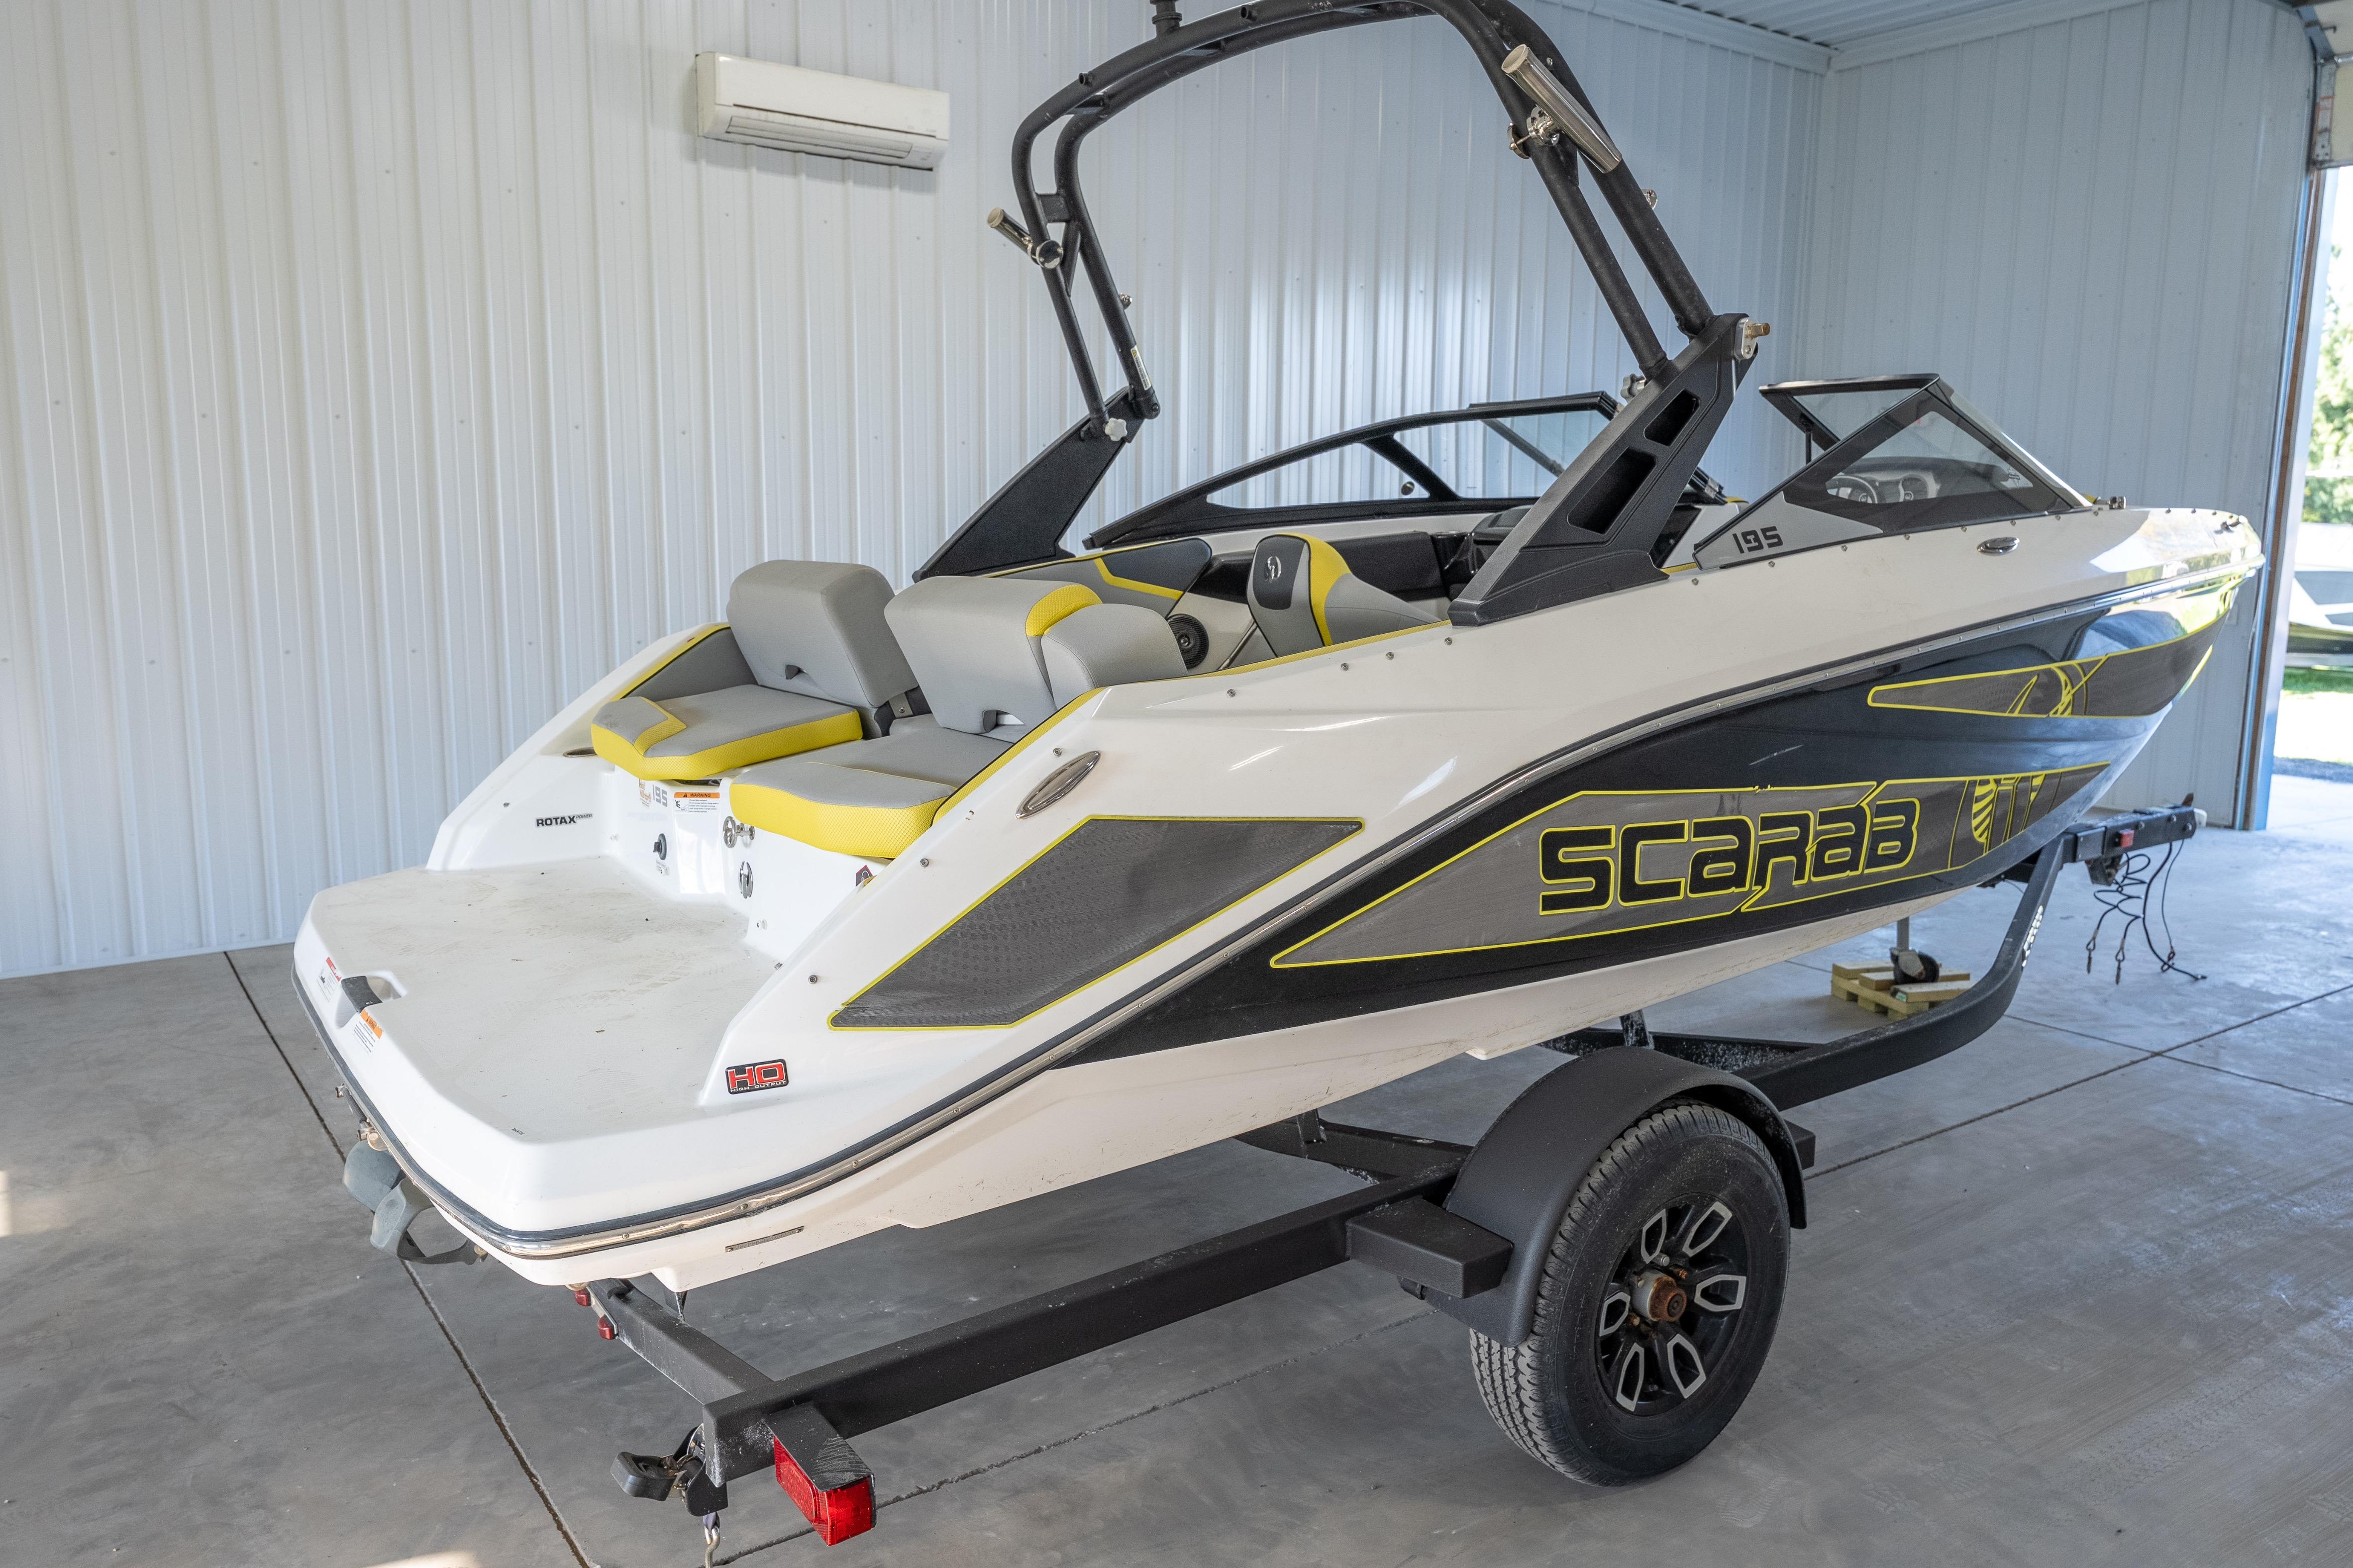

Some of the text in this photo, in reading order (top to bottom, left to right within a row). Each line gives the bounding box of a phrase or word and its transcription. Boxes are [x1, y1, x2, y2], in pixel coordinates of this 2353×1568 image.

[1732, 526, 1783, 554] 195
[652, 784, 668, 808] 195
[536, 815, 576, 827] ROTAX
[727, 1062, 786, 1089] HO
